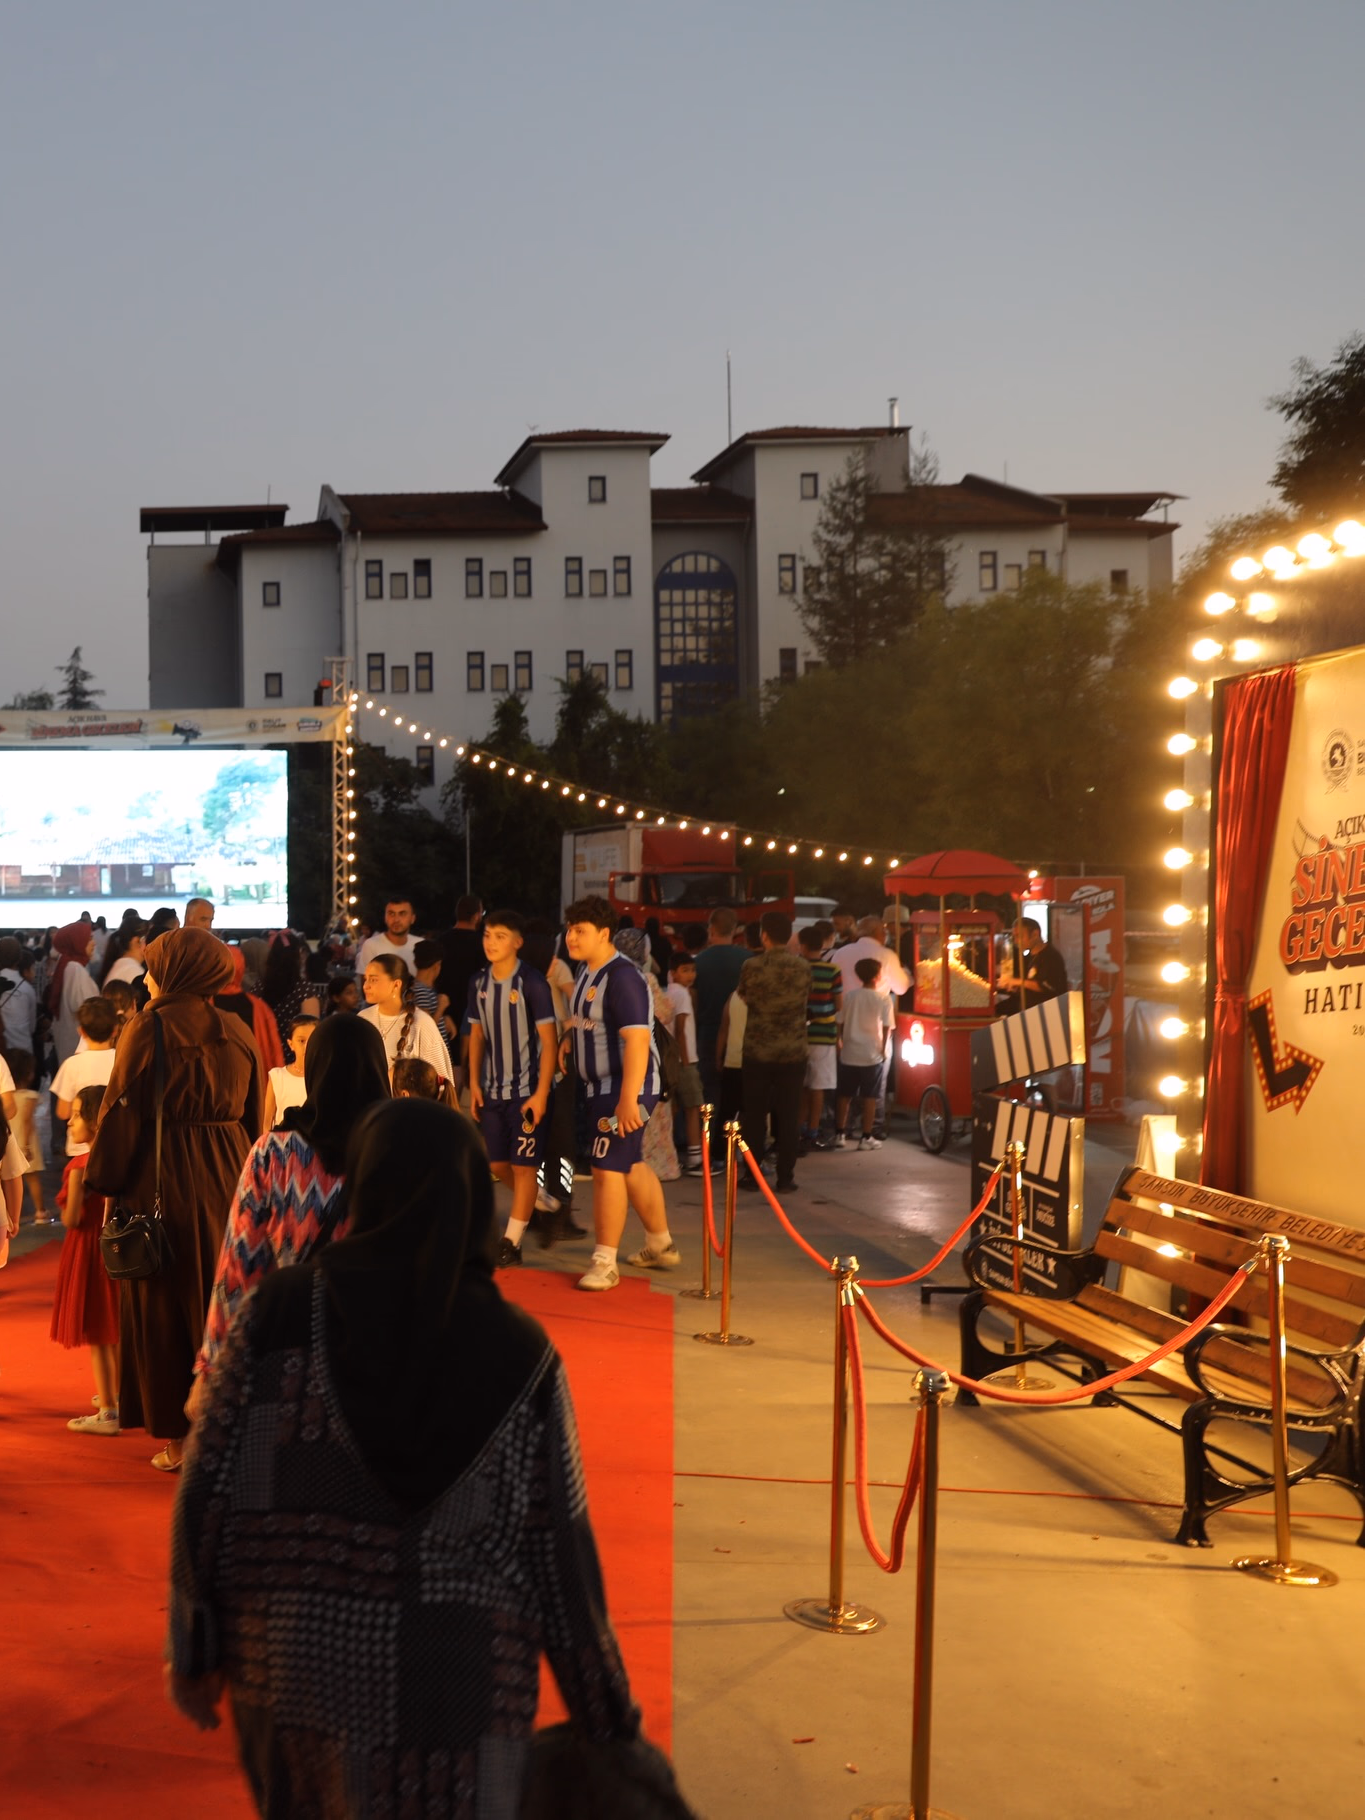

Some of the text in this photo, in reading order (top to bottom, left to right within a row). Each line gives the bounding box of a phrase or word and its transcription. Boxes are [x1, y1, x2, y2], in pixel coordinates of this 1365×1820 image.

[1334, 814, 1365, 844] AÇIK
[517, 1136, 536, 1158] 72
[592, 1136, 611, 1159] 10
[1138, 1175, 1189, 1199] SAMSUN
